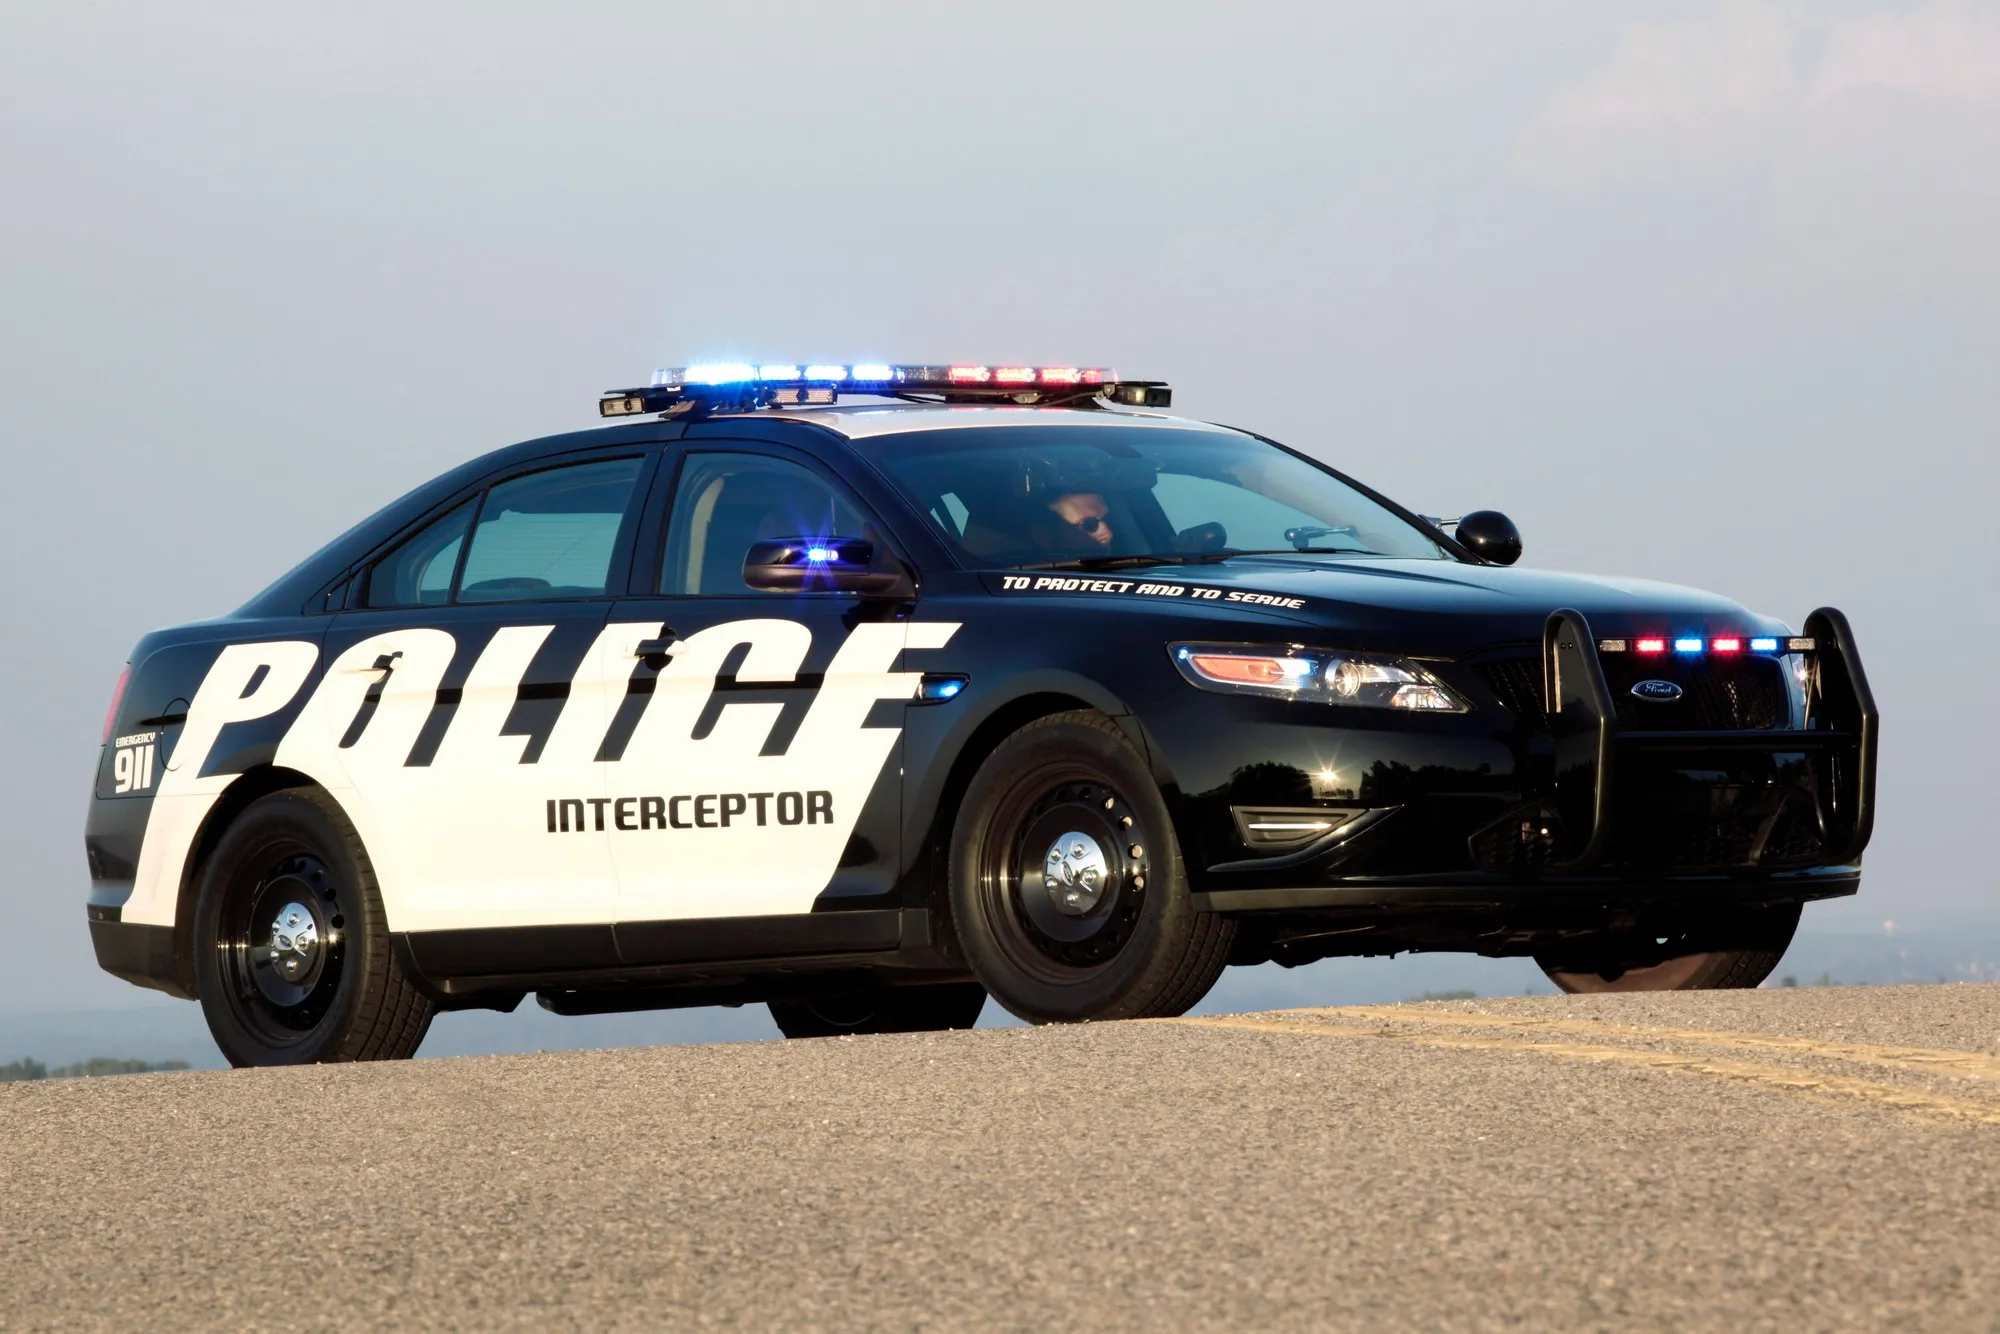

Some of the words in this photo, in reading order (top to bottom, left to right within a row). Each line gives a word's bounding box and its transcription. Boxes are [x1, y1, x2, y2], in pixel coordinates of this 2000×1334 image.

[1002, 575, 1031, 590] TO
[1034, 577, 1134, 593] PROTECT
[1135, 583, 1185, 597] AND
[1192, 587, 1222, 600] TO
[1224, 591, 1306, 609] SERVE
[158, 618, 962, 778] POLICE
[115, 732, 156, 748] EMERGENCY
[114, 744, 154, 794] 911
[546, 790, 834, 833] INTERCEPTOR
